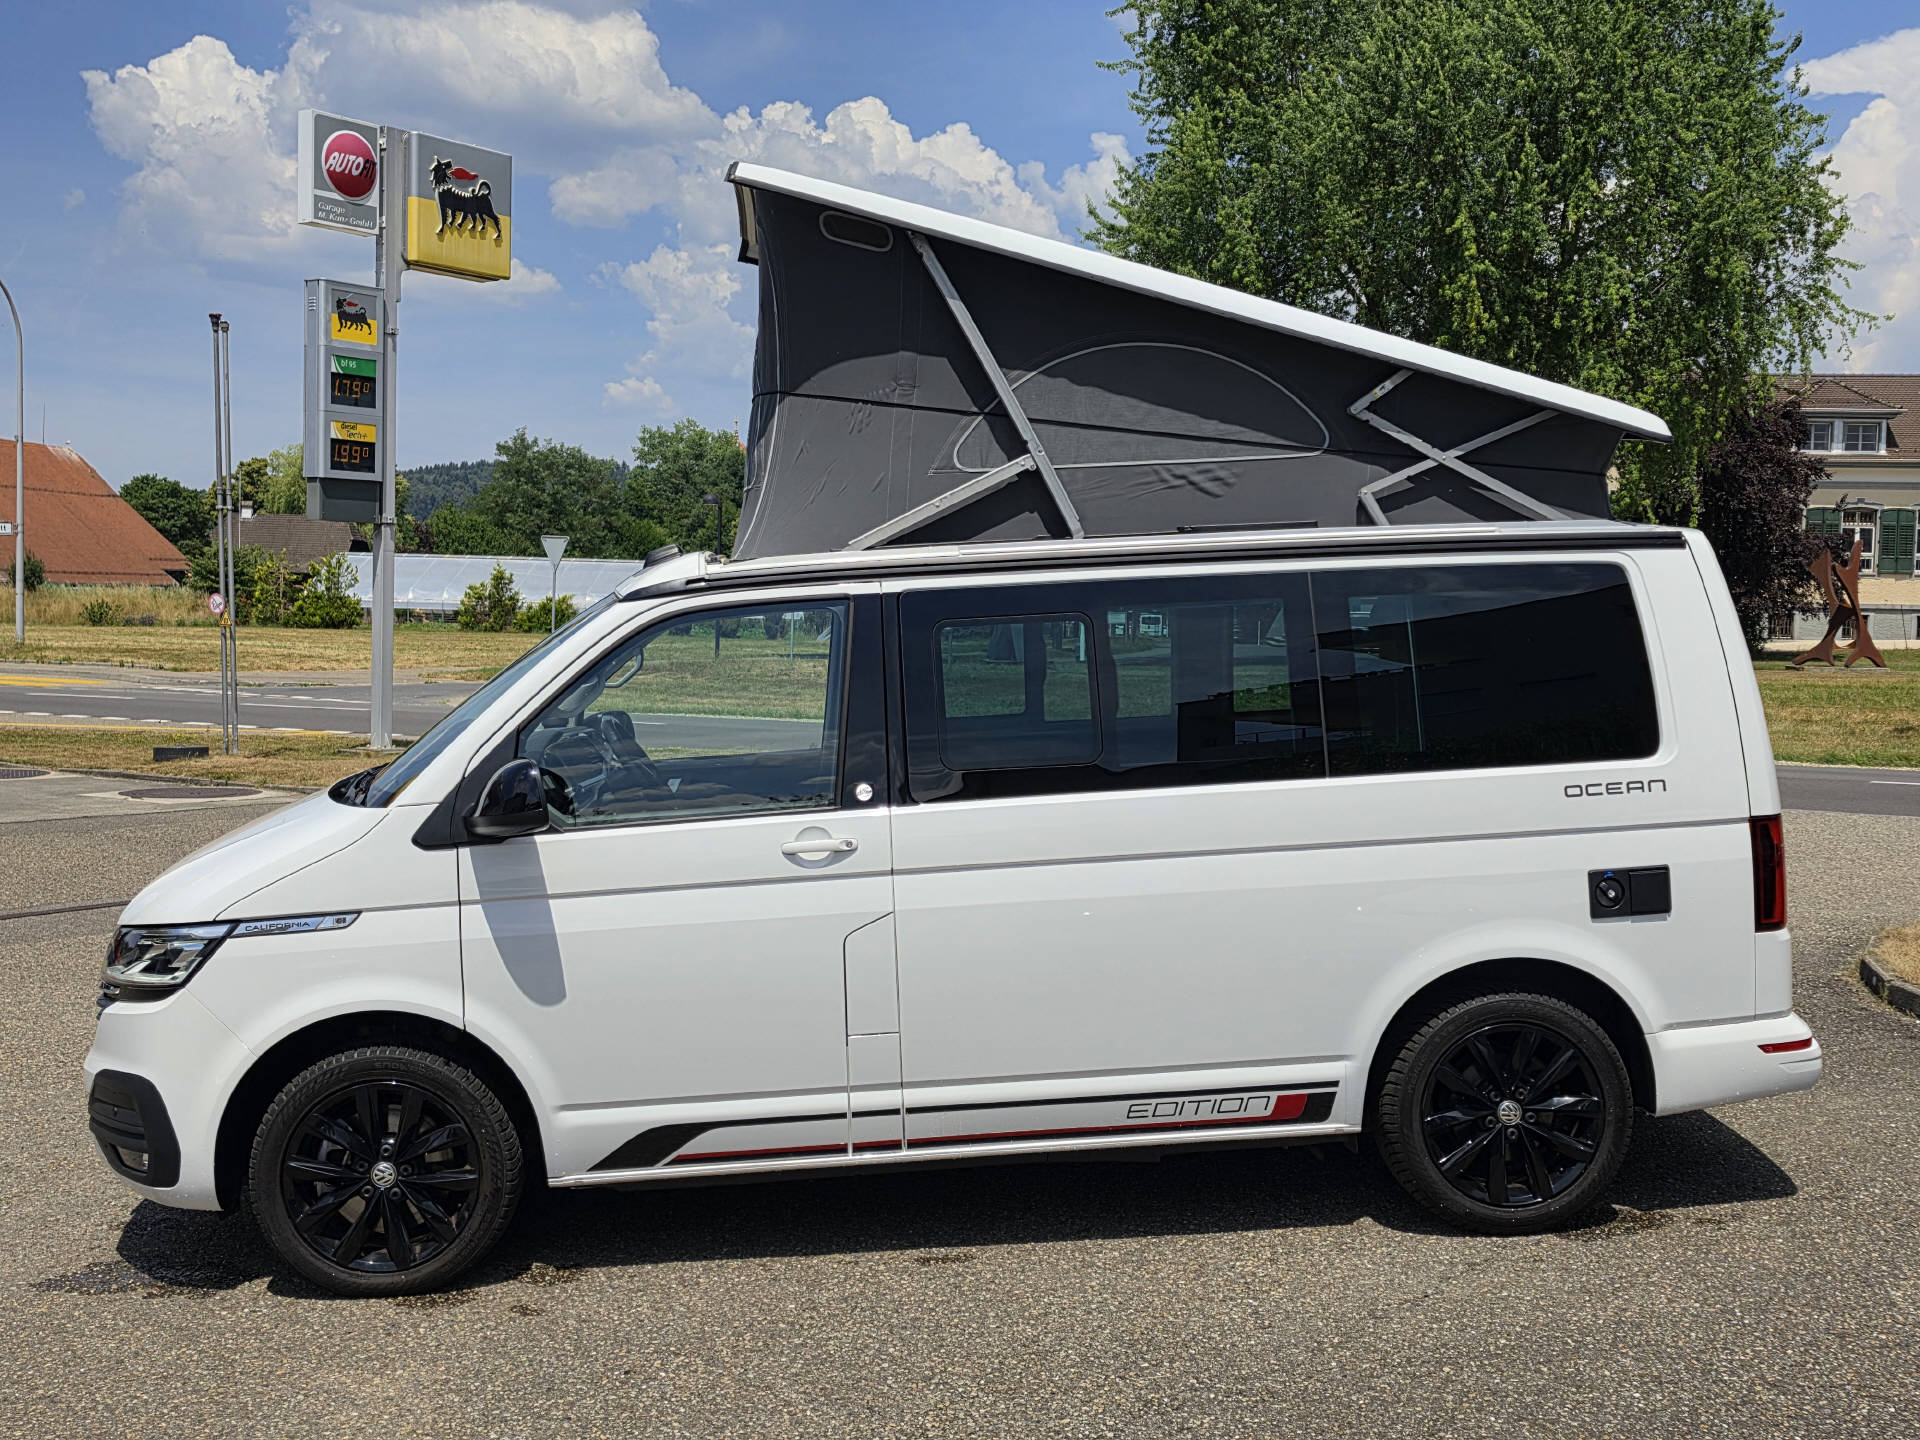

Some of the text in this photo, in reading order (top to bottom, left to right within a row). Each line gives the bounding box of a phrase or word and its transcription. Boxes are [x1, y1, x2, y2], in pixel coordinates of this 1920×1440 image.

[318, 201, 346, 214] Garage
[1564, 779, 1667, 798] OCEAN
[245, 921, 311, 932] CALIFORNIA
[1126, 1096, 1271, 1119] EDITION
